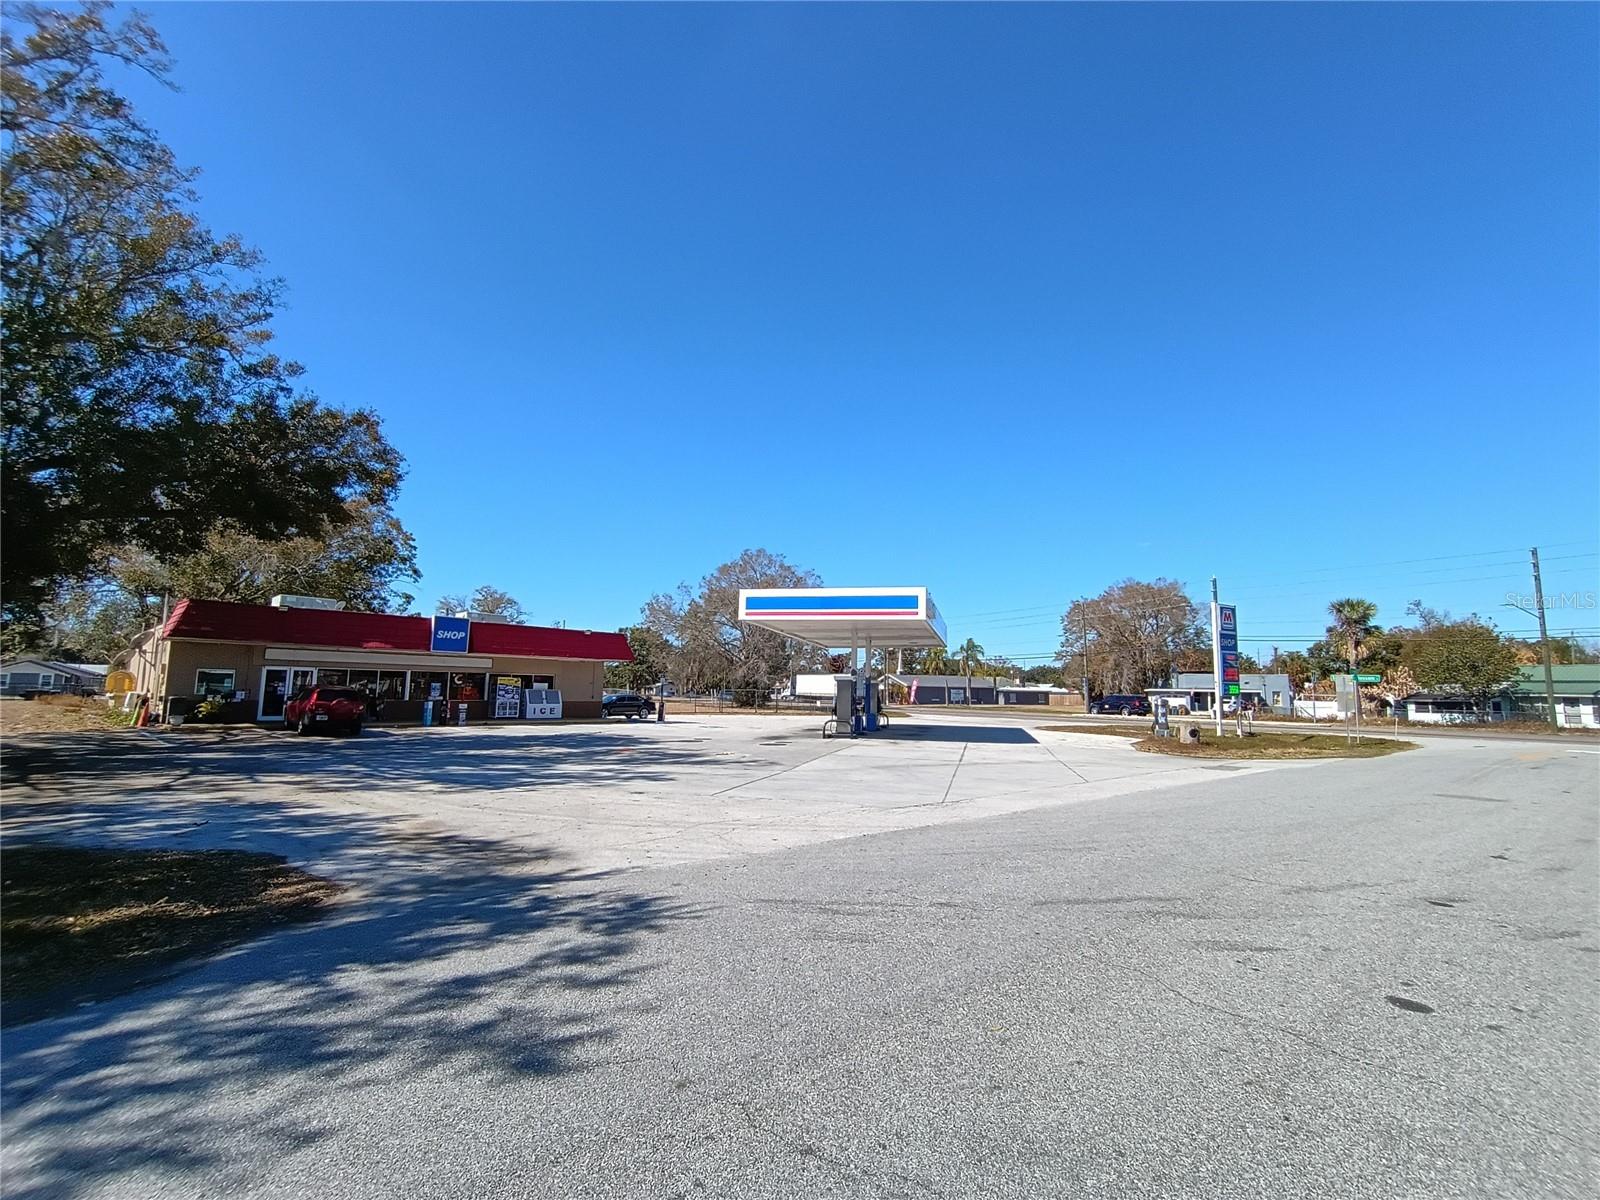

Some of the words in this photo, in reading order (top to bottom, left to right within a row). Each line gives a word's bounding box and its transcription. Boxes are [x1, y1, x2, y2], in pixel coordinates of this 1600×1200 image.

[1223, 612, 1232, 622] M
[436, 630, 466, 640] SHOP
[1221, 639, 1235, 647] SHOP
[533, 707, 556, 715] ICE
